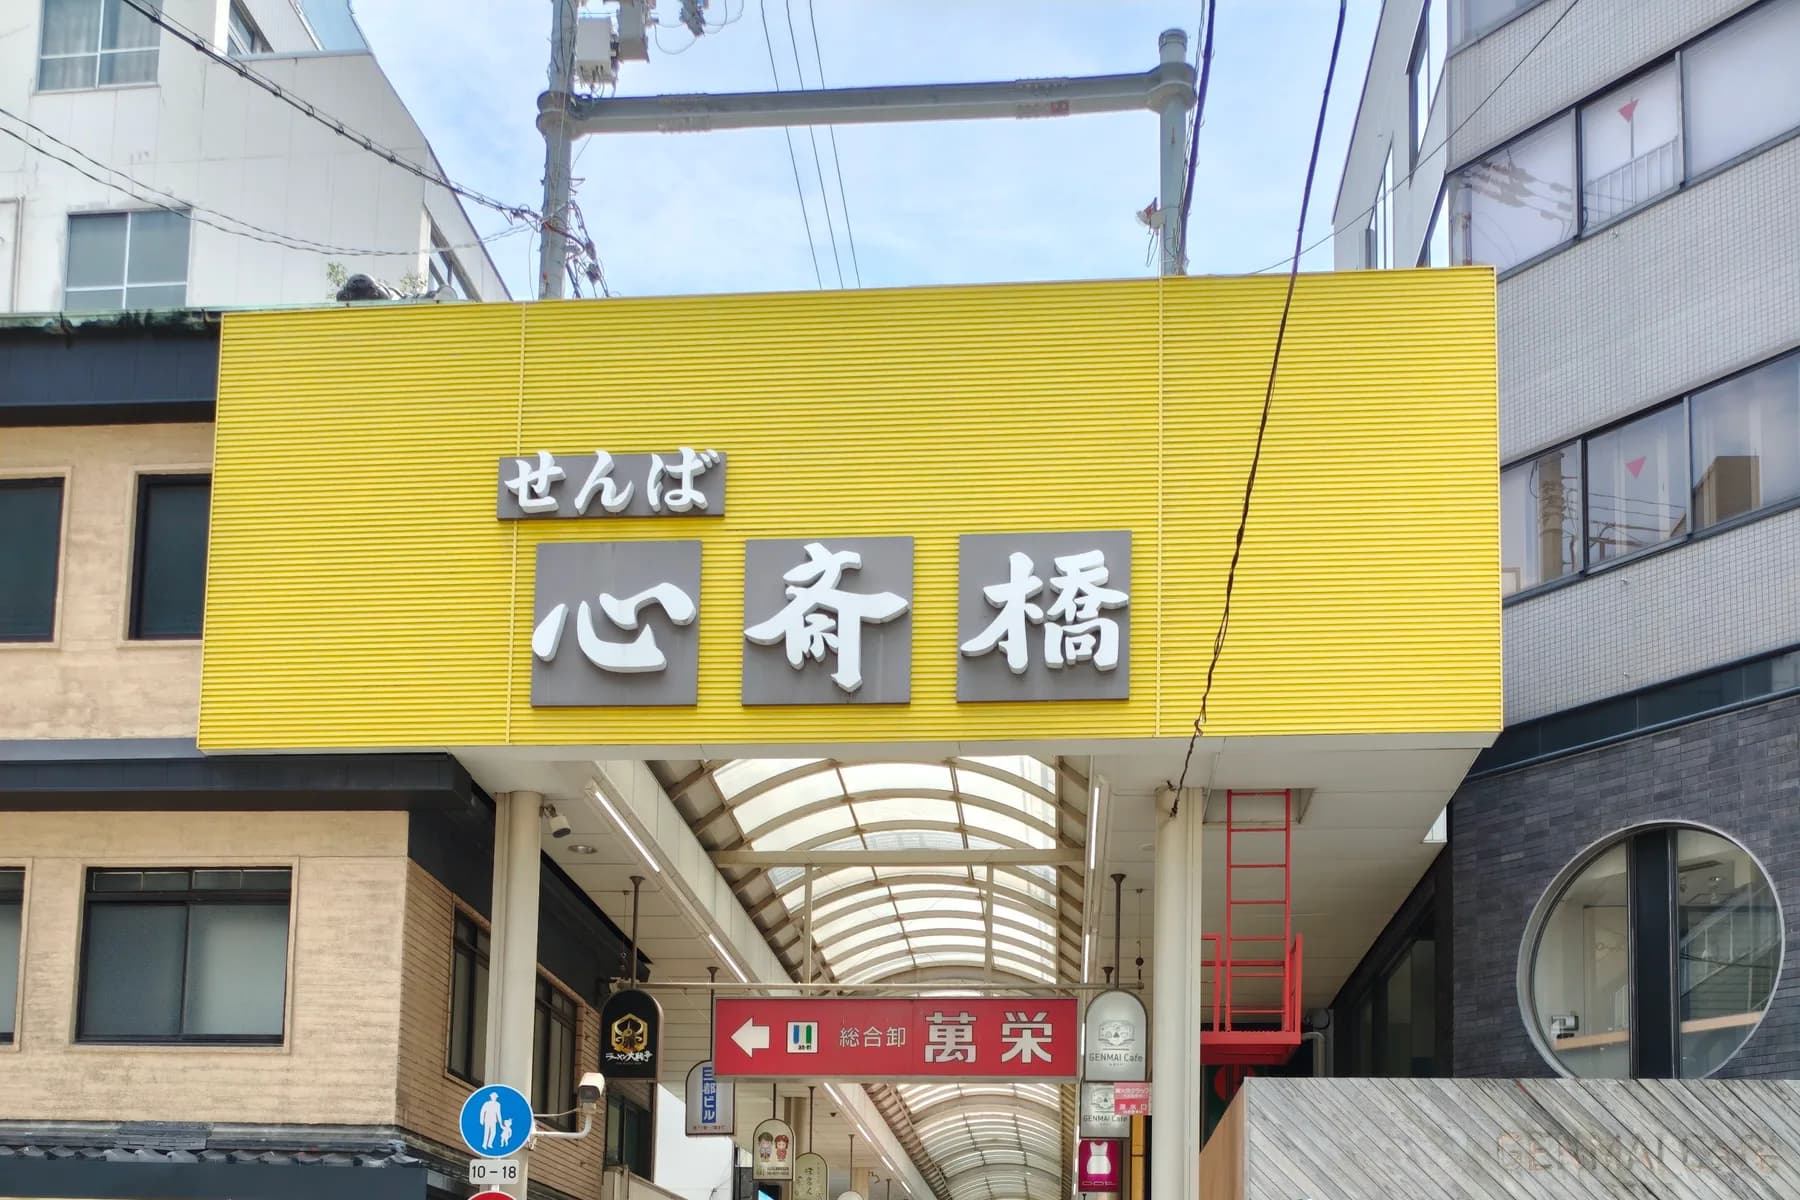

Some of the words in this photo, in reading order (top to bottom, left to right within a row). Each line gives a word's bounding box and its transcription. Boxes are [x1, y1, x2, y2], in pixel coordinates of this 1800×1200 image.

[505, 446, 721, 515] せんば
[532, 541, 1129, 694] 心斎橋
[840, 1026, 906, 1047] 総合卸
[924, 1011, 1053, 1063] 萬栄
[1088, 1052, 1121, 1061] GENMAI
[1124, 1052, 1143, 1062] Cafe
